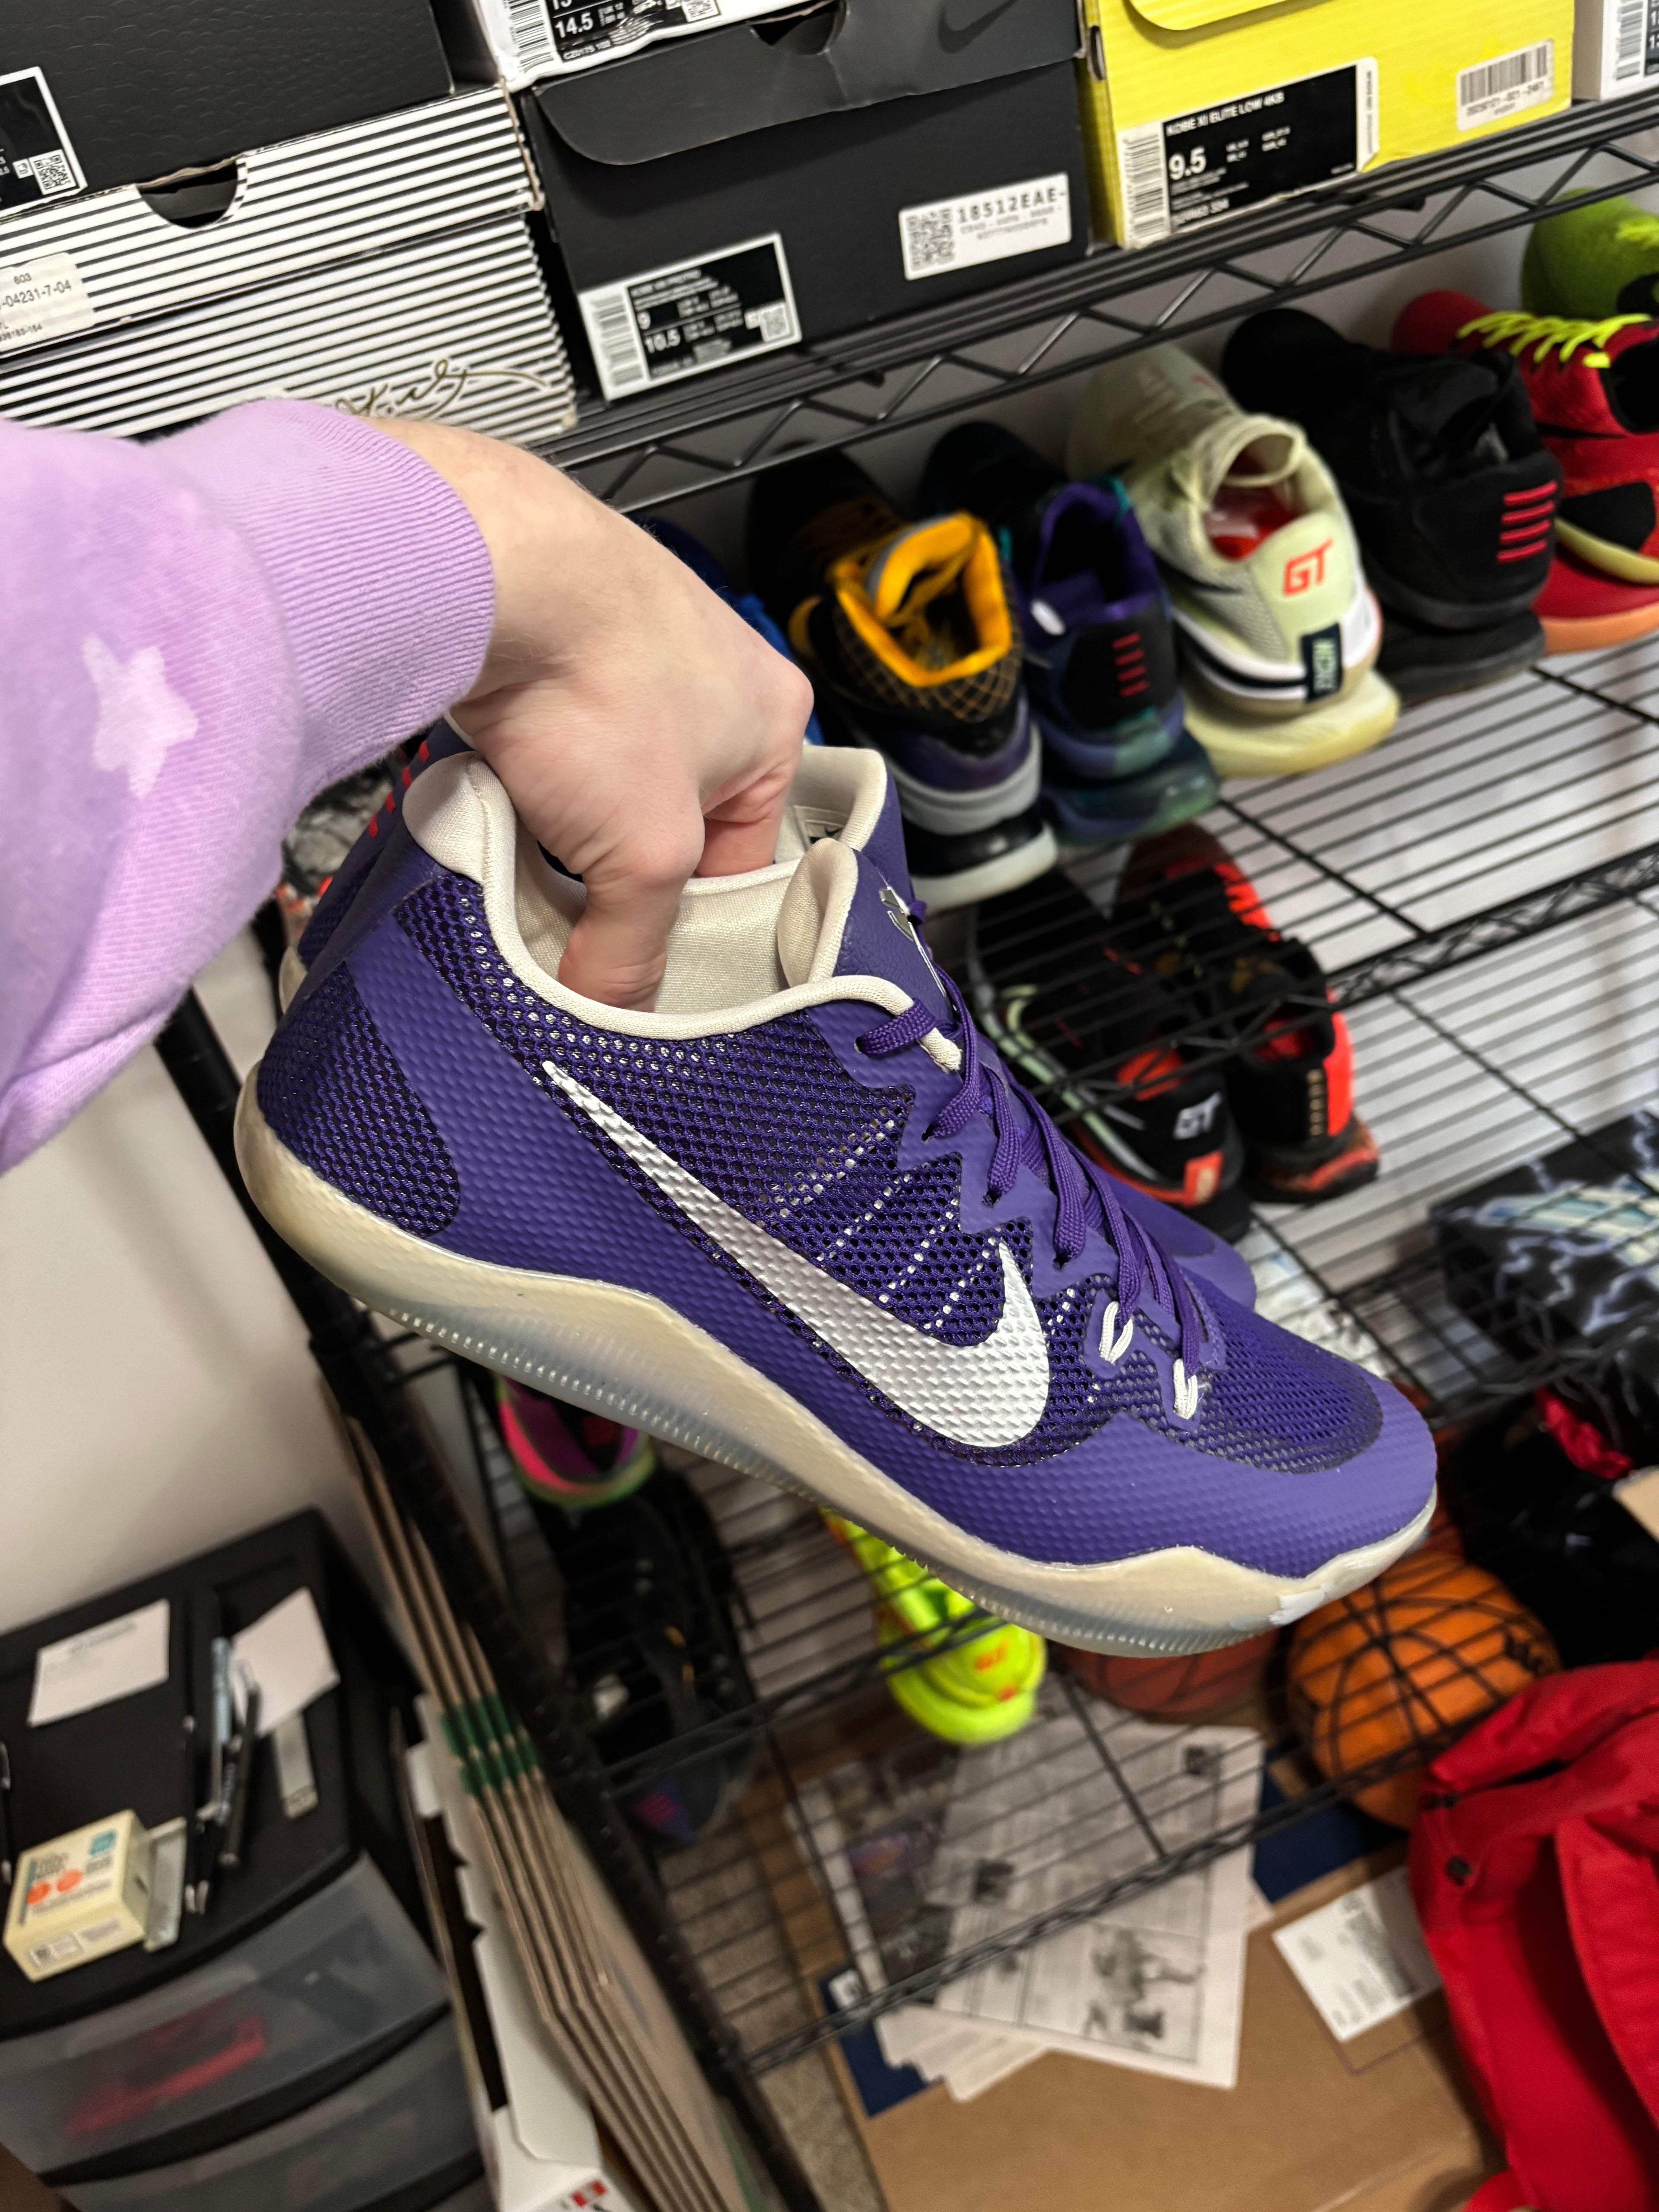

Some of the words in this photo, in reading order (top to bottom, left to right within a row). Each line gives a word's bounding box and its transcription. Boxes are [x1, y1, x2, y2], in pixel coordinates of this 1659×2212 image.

[555, 12, 593, 38] 14.5
[1239, 98, 1263, 115] LOW
[1169, 145, 1207, 180] 9.5
[13, 273, 32, 284] 603
[0, 280, 72, 309] -04231-7-04
[637, 310, 651, 330] 9
[644, 328, 681, 353] 10.5
[1283, 537, 1335, 597] GT
